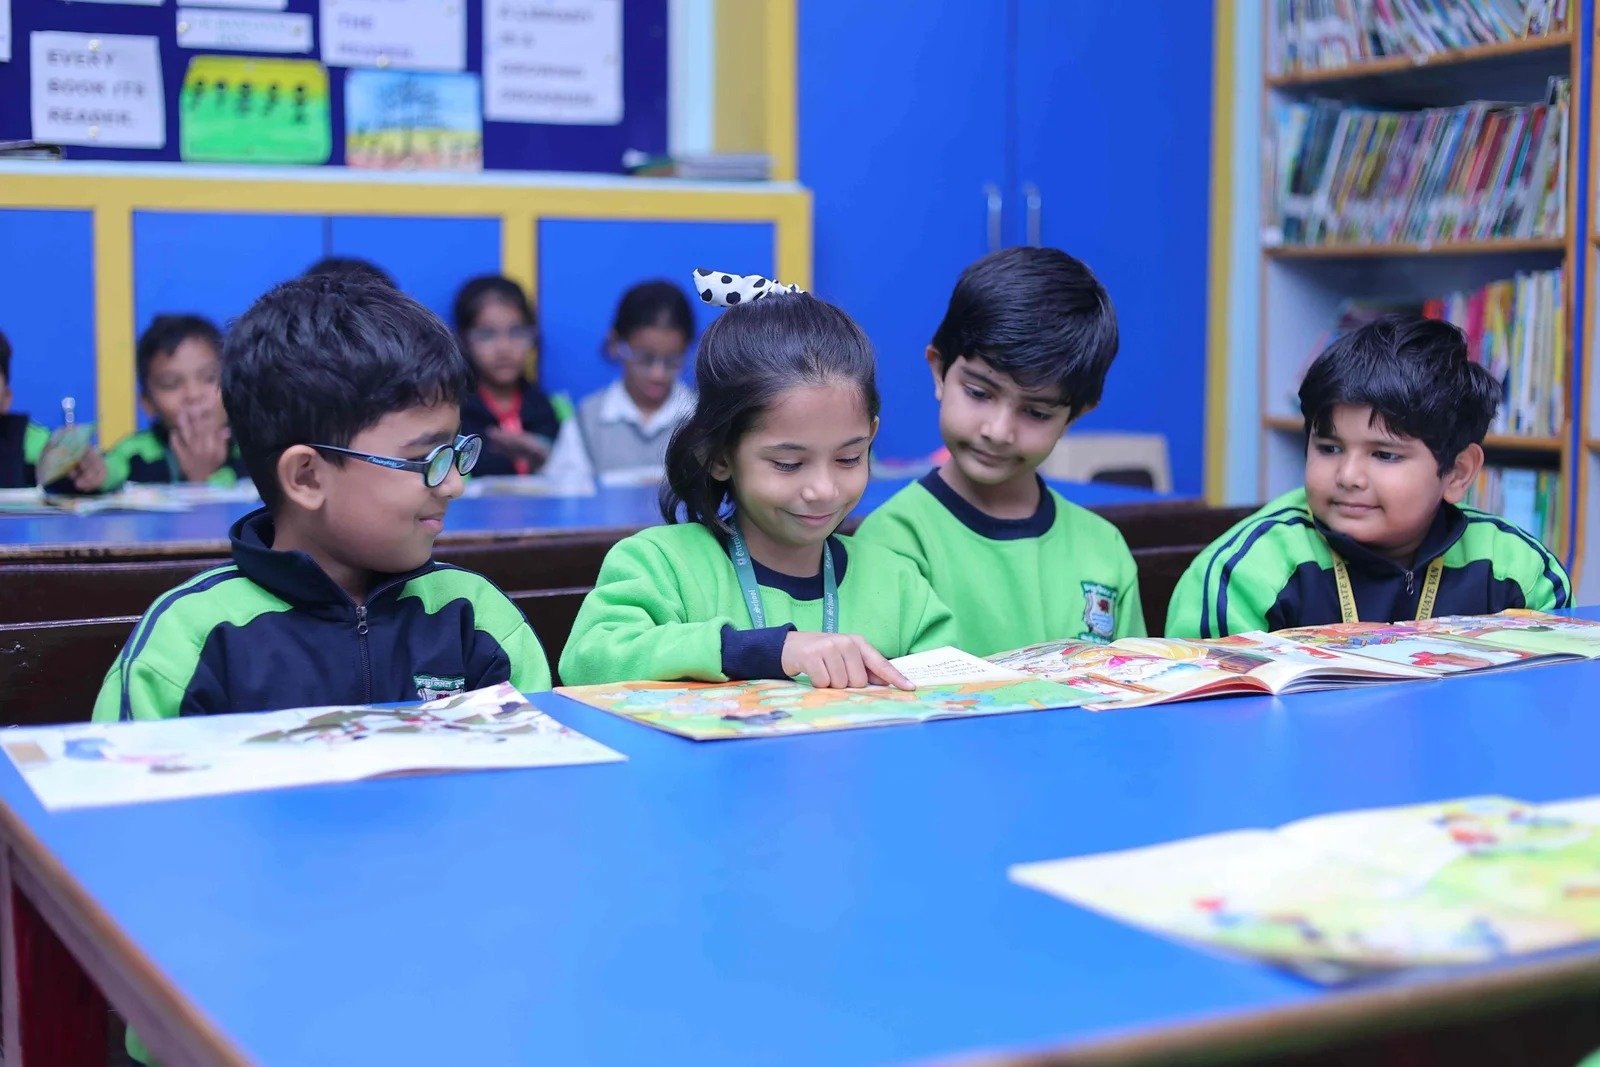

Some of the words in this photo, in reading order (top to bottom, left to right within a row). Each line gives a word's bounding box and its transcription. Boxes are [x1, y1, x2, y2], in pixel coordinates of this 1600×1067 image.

[47, 50, 115, 67] EVERY
[47, 78, 105, 96] BOOK
[112, 80, 146, 98] ITS
[1419, 588, 1435, 620] RIVATE
[1430, 567, 1440, 587] VAN
